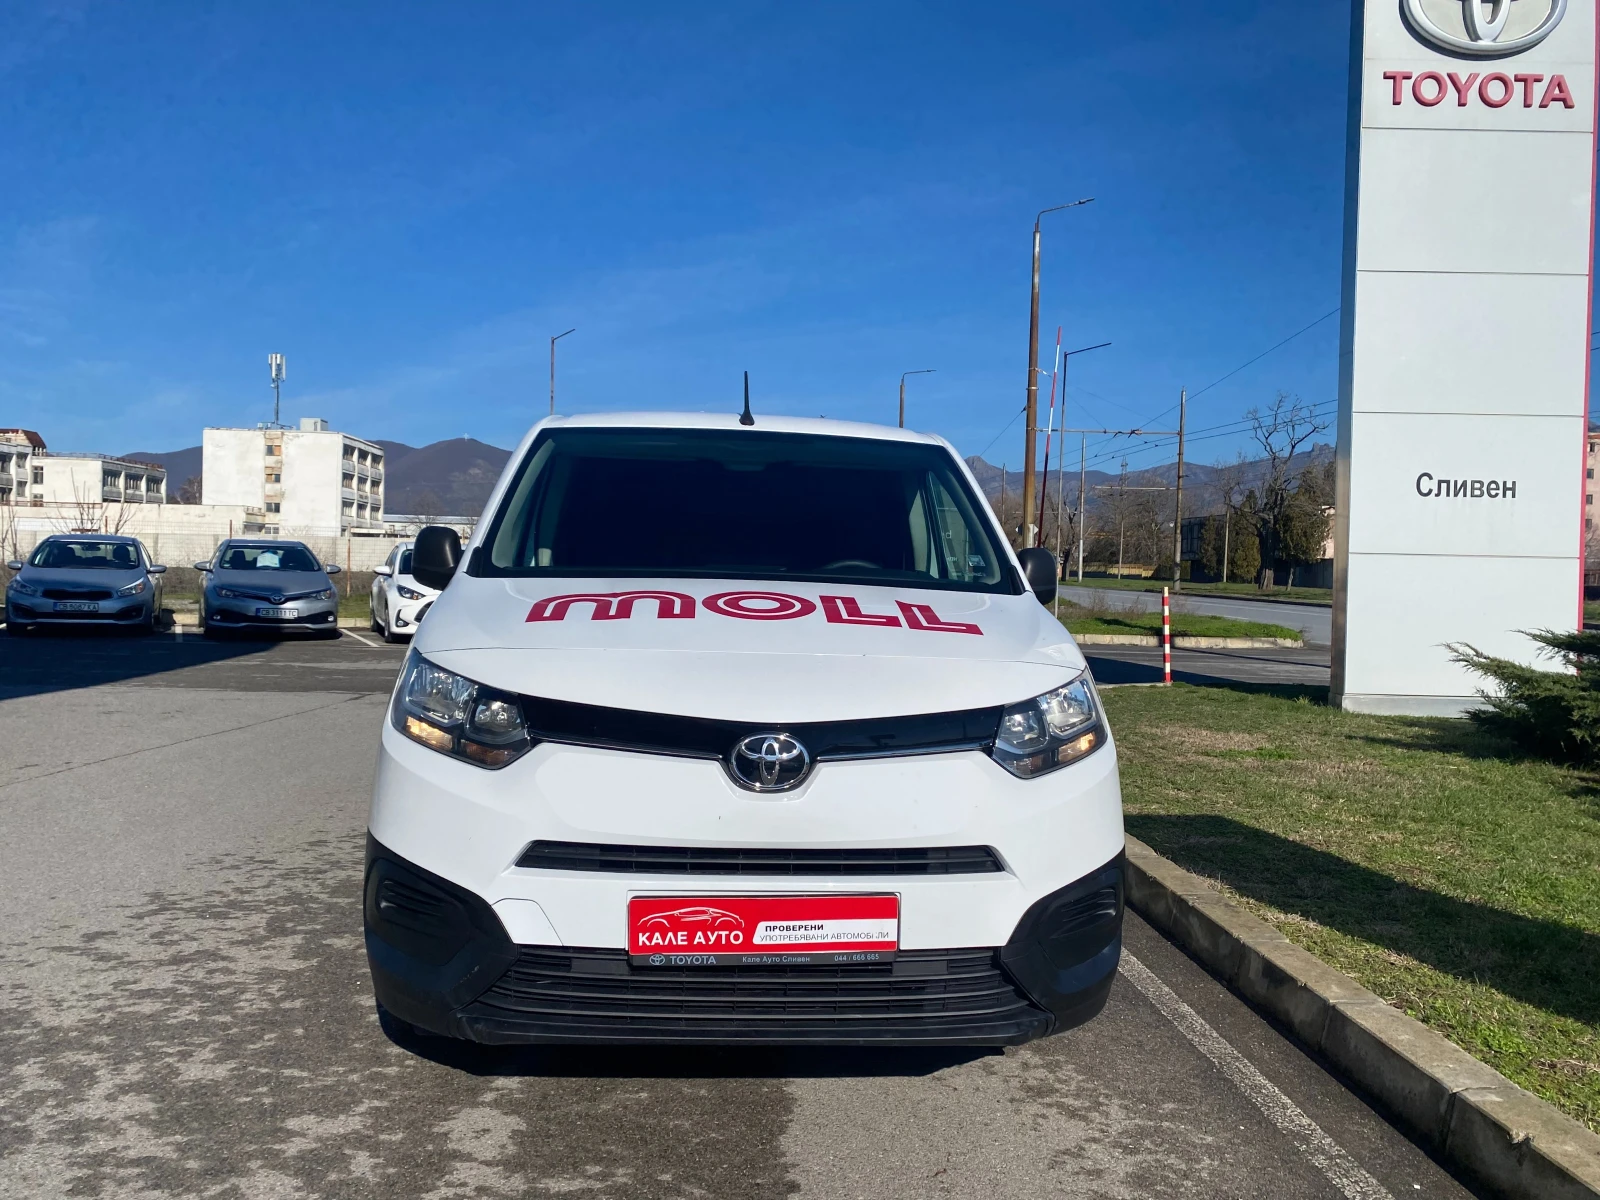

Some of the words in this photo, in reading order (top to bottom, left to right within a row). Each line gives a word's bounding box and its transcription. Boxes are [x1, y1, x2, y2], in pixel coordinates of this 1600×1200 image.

[1383, 71, 1575, 109] TOYOTA
[1416, 472, 1517, 499] Сливен
[765, 924, 824, 932] ПРОВЕРЕНИ
[638, 931, 688, 946] КАЛЕ
[693, 931, 744, 945] АУТО
[759, 933, 829, 942] УПОТРЕБЯВАНИ
[670, 955, 717, 965] TOYOTA
[762, 956, 781, 964] Ауто
[782, 955, 811, 963] Сливен
[834, 954, 847, 962] 044
